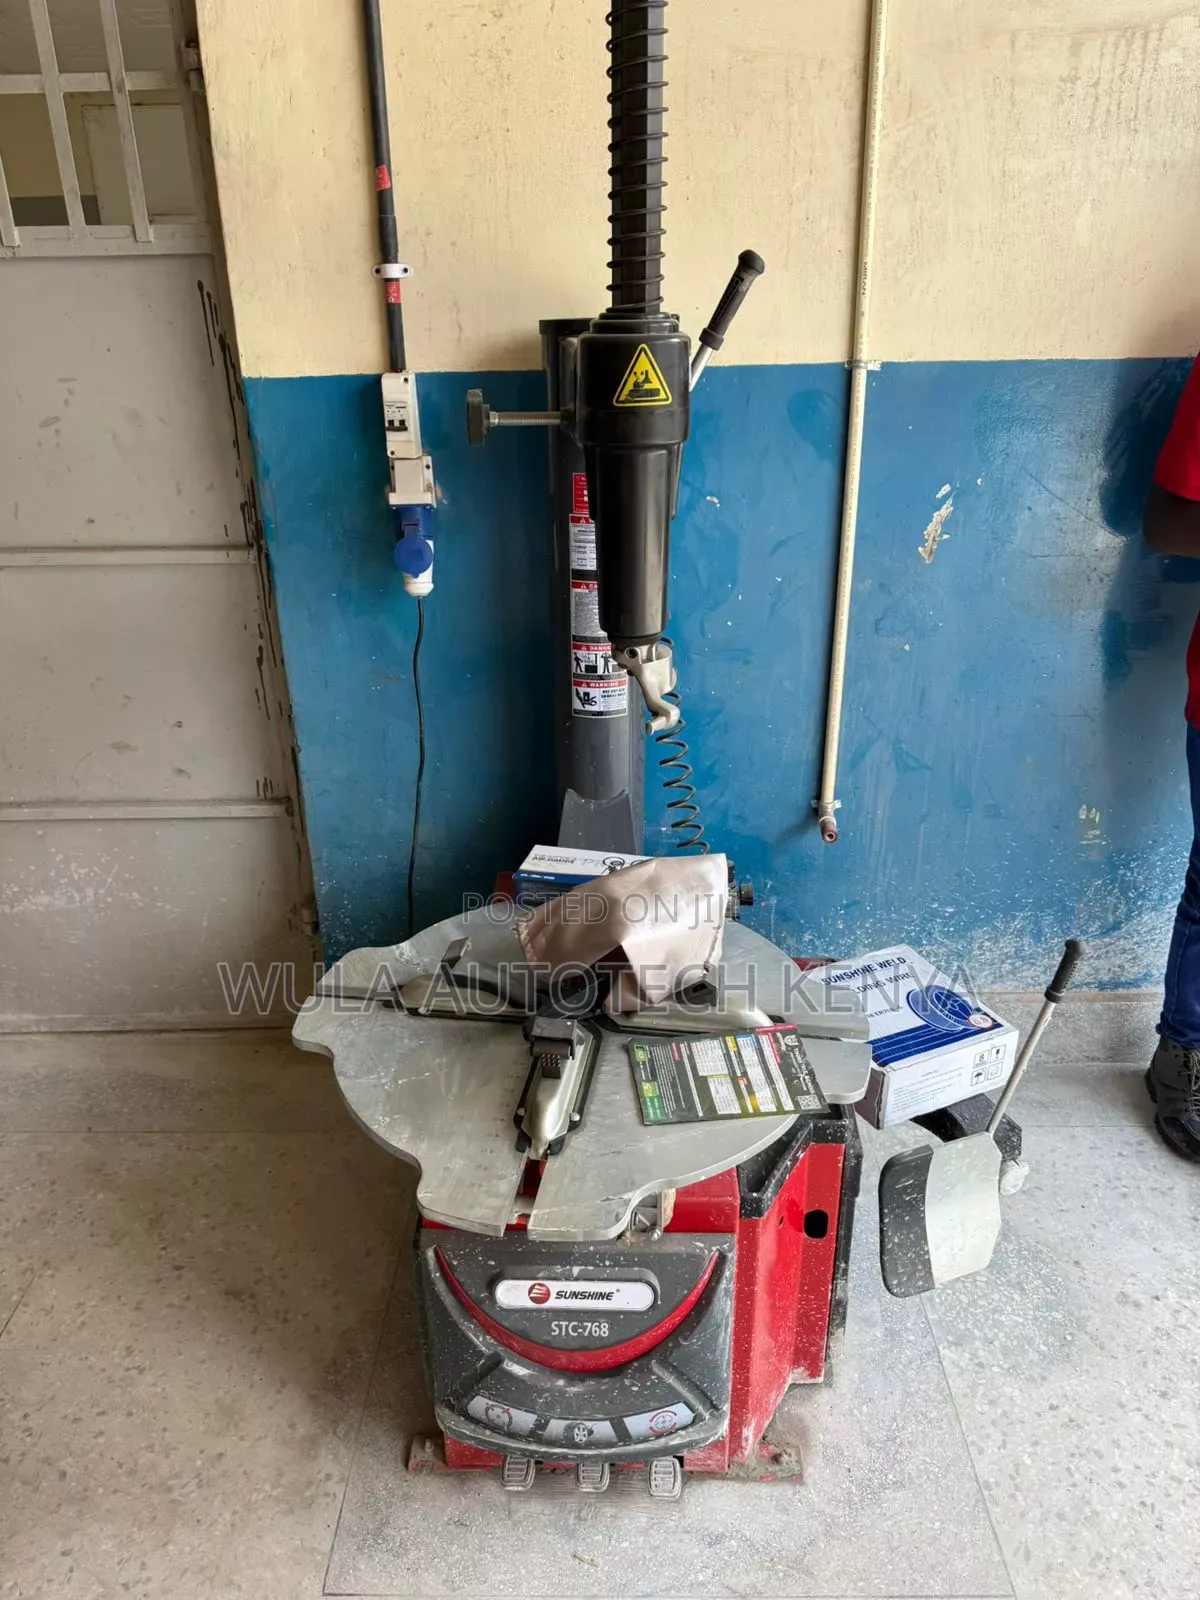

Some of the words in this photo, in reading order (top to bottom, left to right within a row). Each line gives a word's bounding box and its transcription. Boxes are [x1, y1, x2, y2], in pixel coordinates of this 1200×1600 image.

[821, 964, 877, 986] SUNSHINE
[876, 957, 906, 969] WELD
[885, 972, 915, 984] WIRE
[554, 1290, 615, 1301] SUNSHINE
[551, 1321, 609, 1337] STC-768
